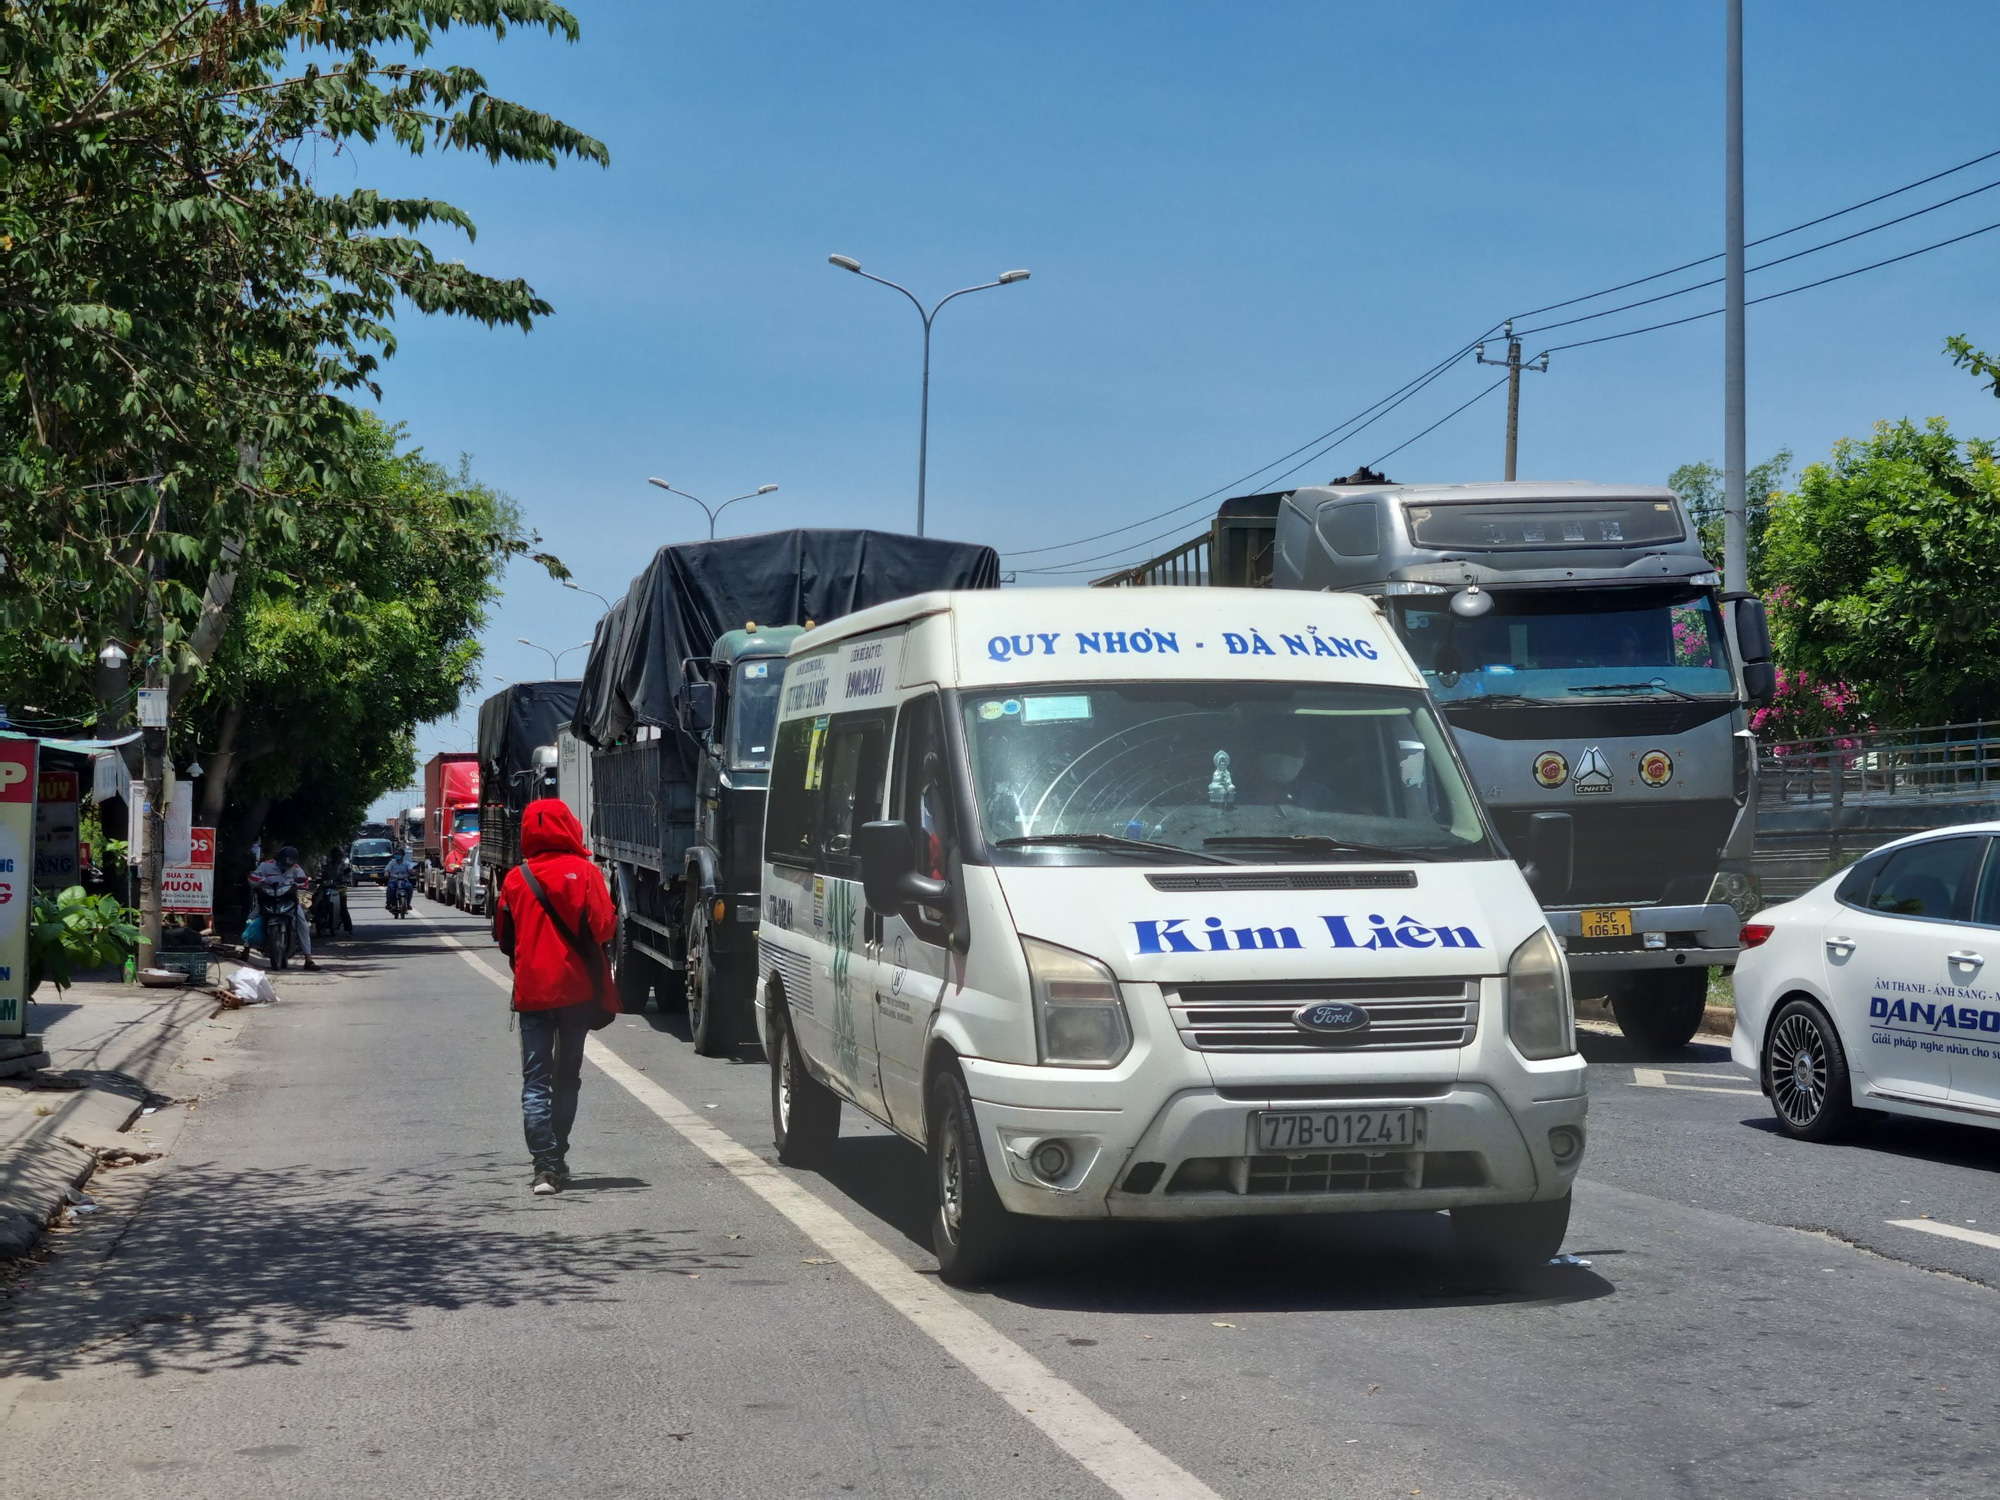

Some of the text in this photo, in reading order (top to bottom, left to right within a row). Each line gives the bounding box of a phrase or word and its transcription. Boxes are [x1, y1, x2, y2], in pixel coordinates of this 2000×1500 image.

[987, 632, 1061, 662] QUY
[1074, 627, 1180, 655] NHƠN
[1221, 627, 1277, 656] ĐÀ
[1279, 625, 1379, 661] NẴNG
[1577, 785, 1612, 793] CNHTC
[1595, 911, 1617, 923] 35C
[1128, 914, 1487, 955] Kim Liên
[1588, 924, 1626, 937] 106.51
[1891, 981, 1926, 994] THANH
[1933, 983, 1955, 997] ÁNH
[1957, 985, 1986, 1000] SÁNG
[1313, 1007, 1354, 1025] Ford
[1870, 997, 2000, 1032] DANASO
[1872, 1033, 1891, 1045] Giải
[1893, 1036, 1918, 1050] pháp
[1920, 1041, 1945, 1053] nghe
[1946, 1044, 1970, 1056] nhìn
[1971, 1046, 1990, 1058] cho
[1265, 1113, 1407, 1147] 77B-012.41
